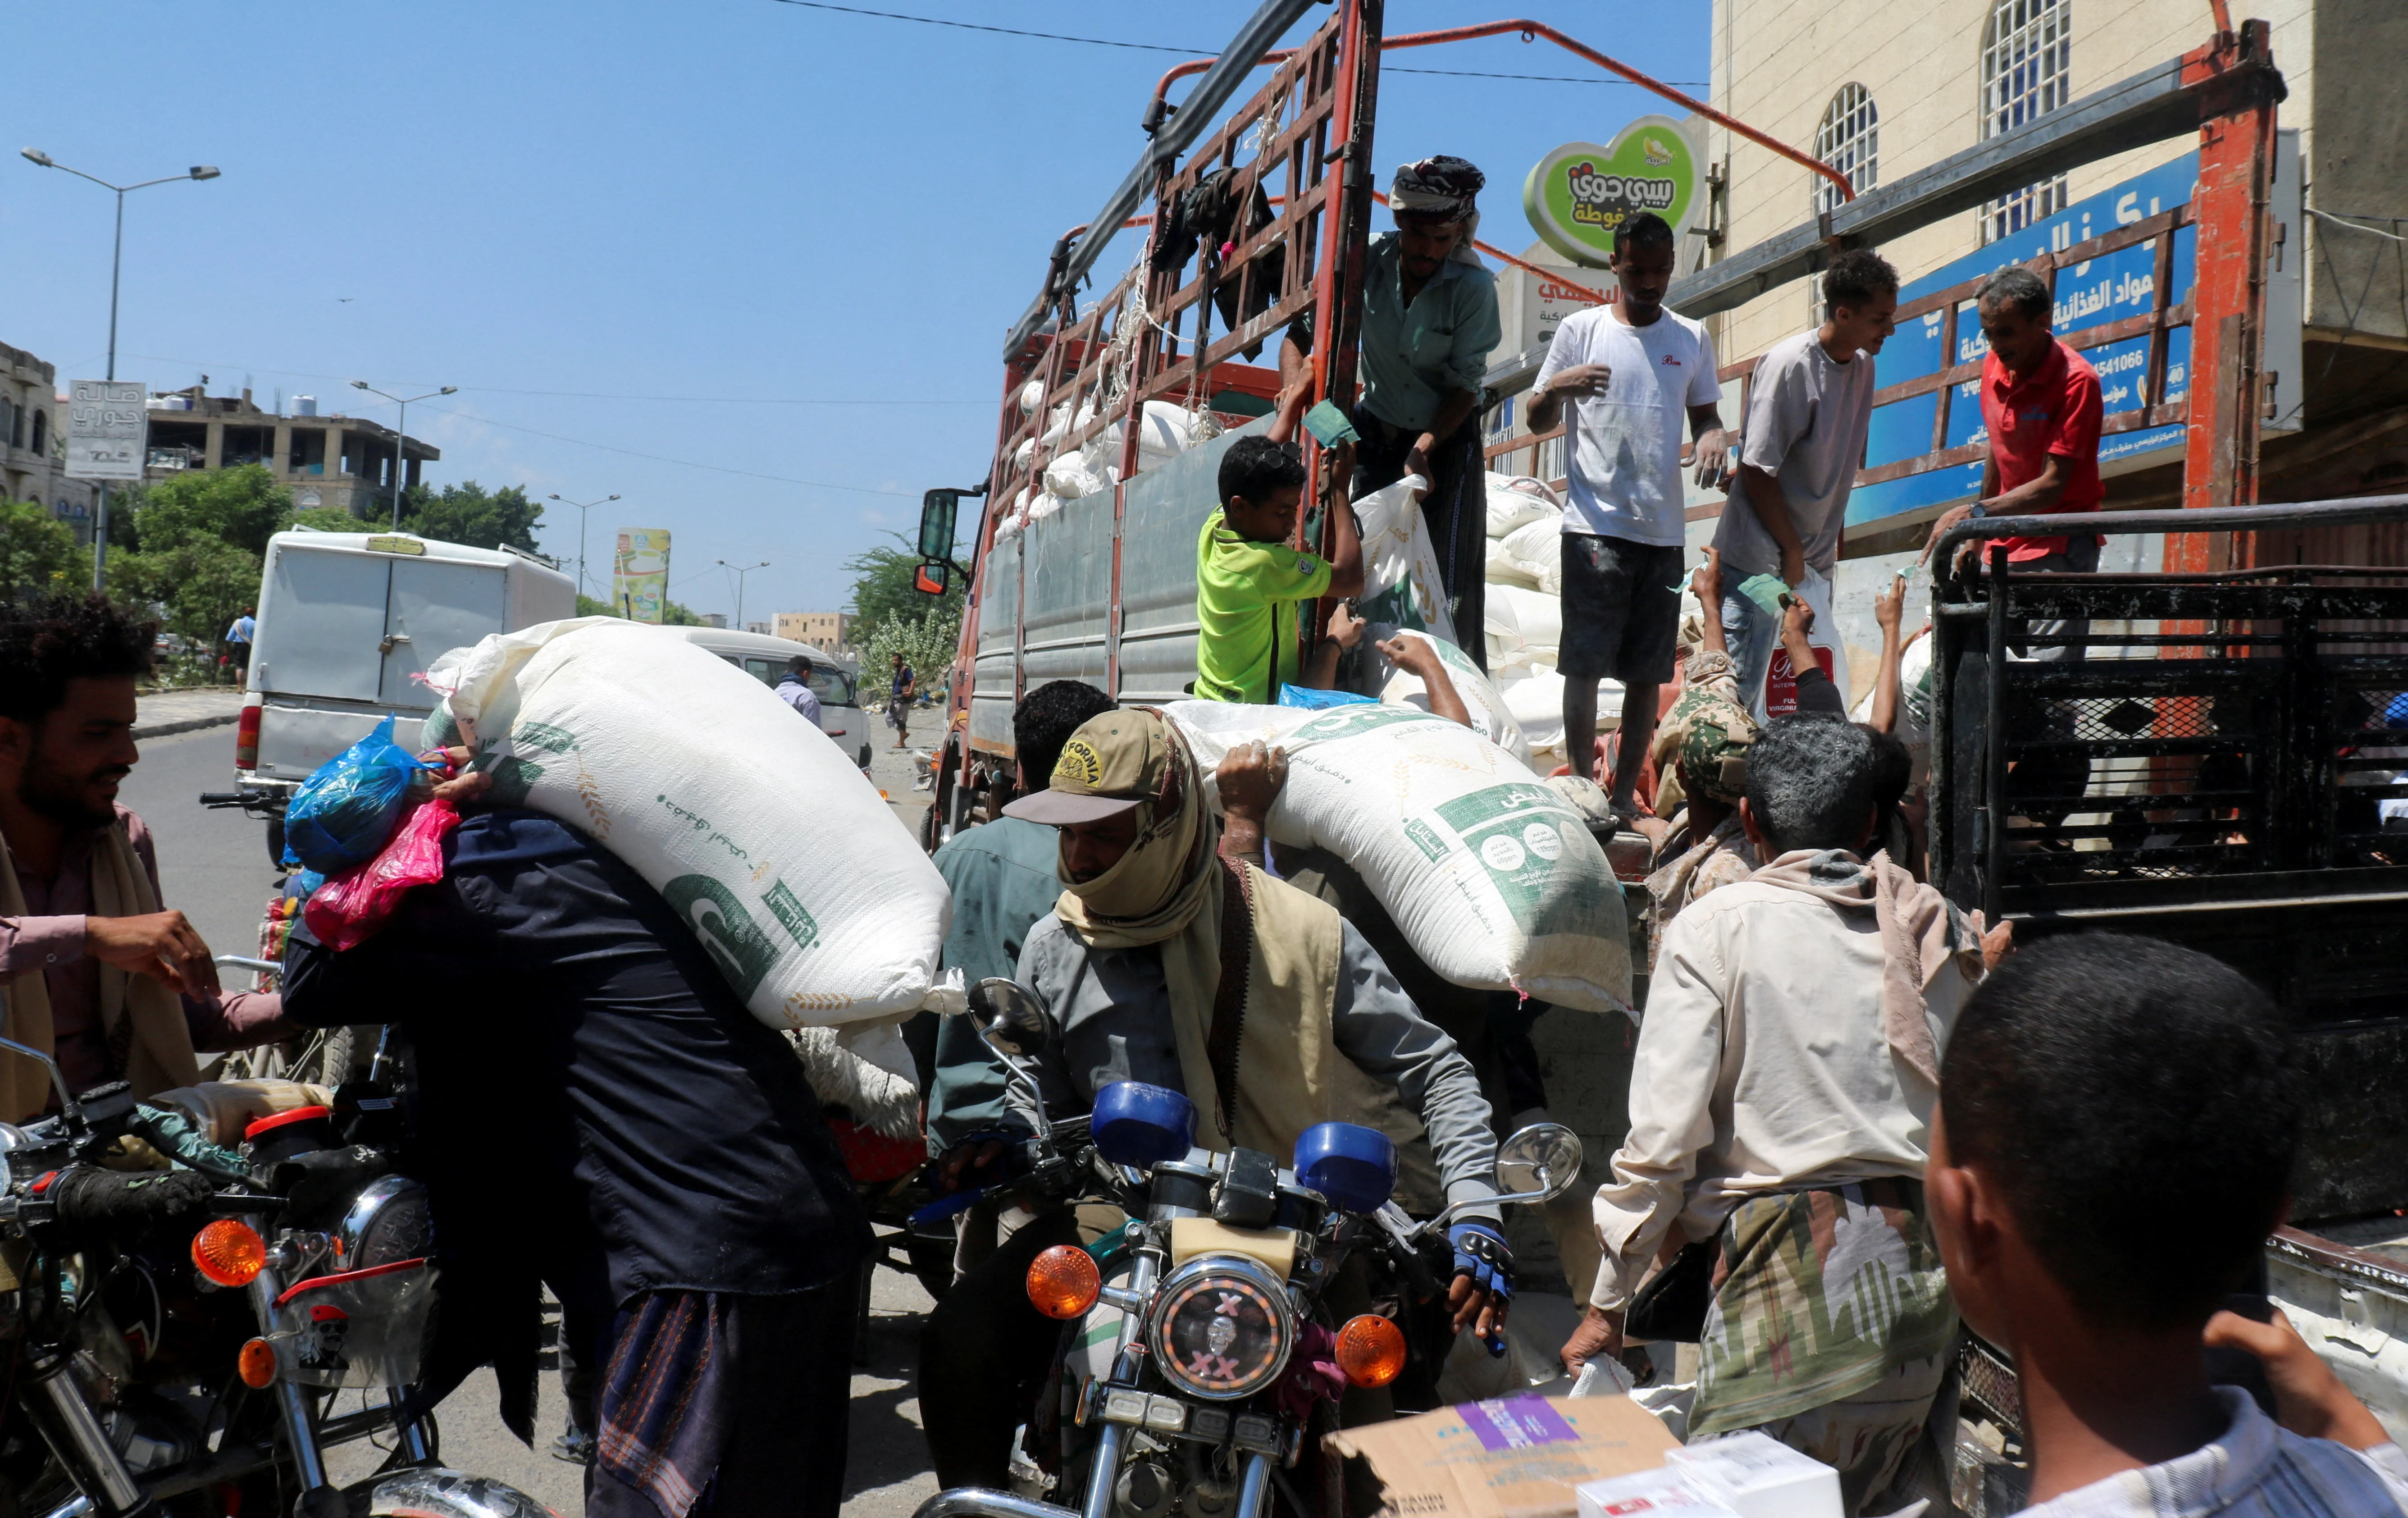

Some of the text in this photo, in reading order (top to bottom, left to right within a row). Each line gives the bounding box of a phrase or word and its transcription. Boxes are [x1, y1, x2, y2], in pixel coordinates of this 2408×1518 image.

[1574, 204, 1627, 229] غوطة
[2115, 271, 2153, 305] مواد
[2052, 279, 2111, 330] الغذائية
[75, 384, 140, 403] صالة
[72, 407, 142, 428] جوري
[1057, 741, 1099, 784] IFORNIA
[1315, 764, 1345, 780] دقيق
[666, 801, 711, 830] دقيق
[1496, 854, 1518, 864] 60ppm
[1471, 903, 1490, 929] دقيق
